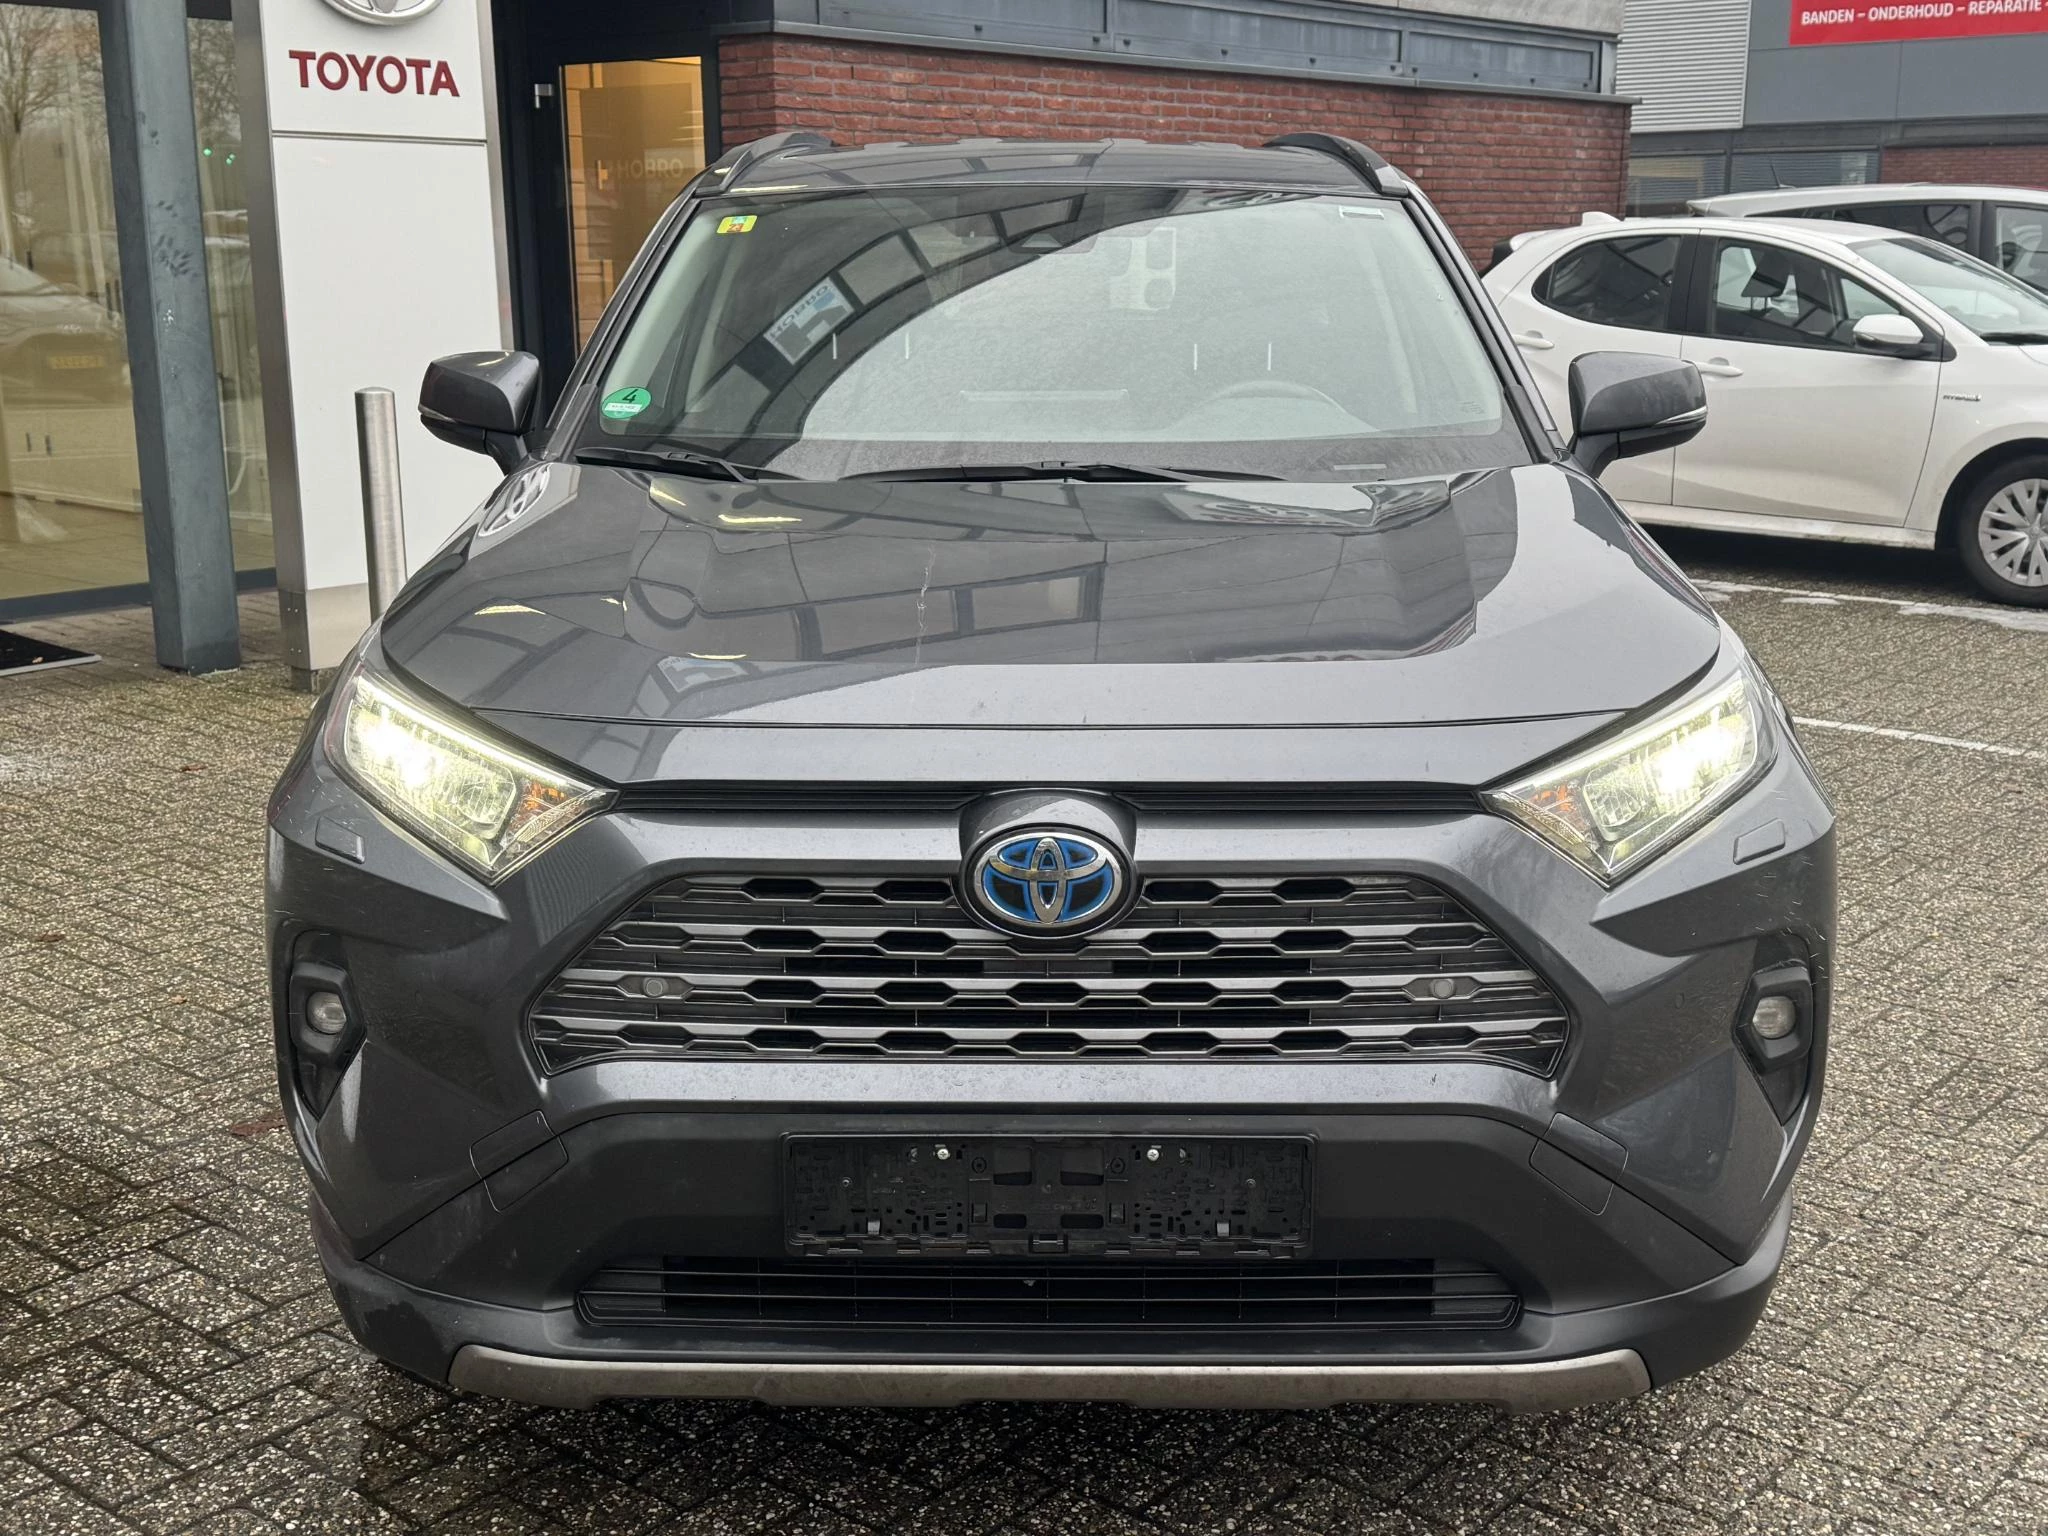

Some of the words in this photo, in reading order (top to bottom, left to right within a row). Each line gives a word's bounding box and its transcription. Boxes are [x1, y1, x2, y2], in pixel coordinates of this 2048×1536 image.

[1801, 9, 1855, 26] BANDEN
[1868, 3, 1954, 22] ONDERHOUD
[1967, 0, 2042, 15] REPARATIE
[288, 49, 461, 98] TOYOTA
[622, 388, 638, 404] 4
